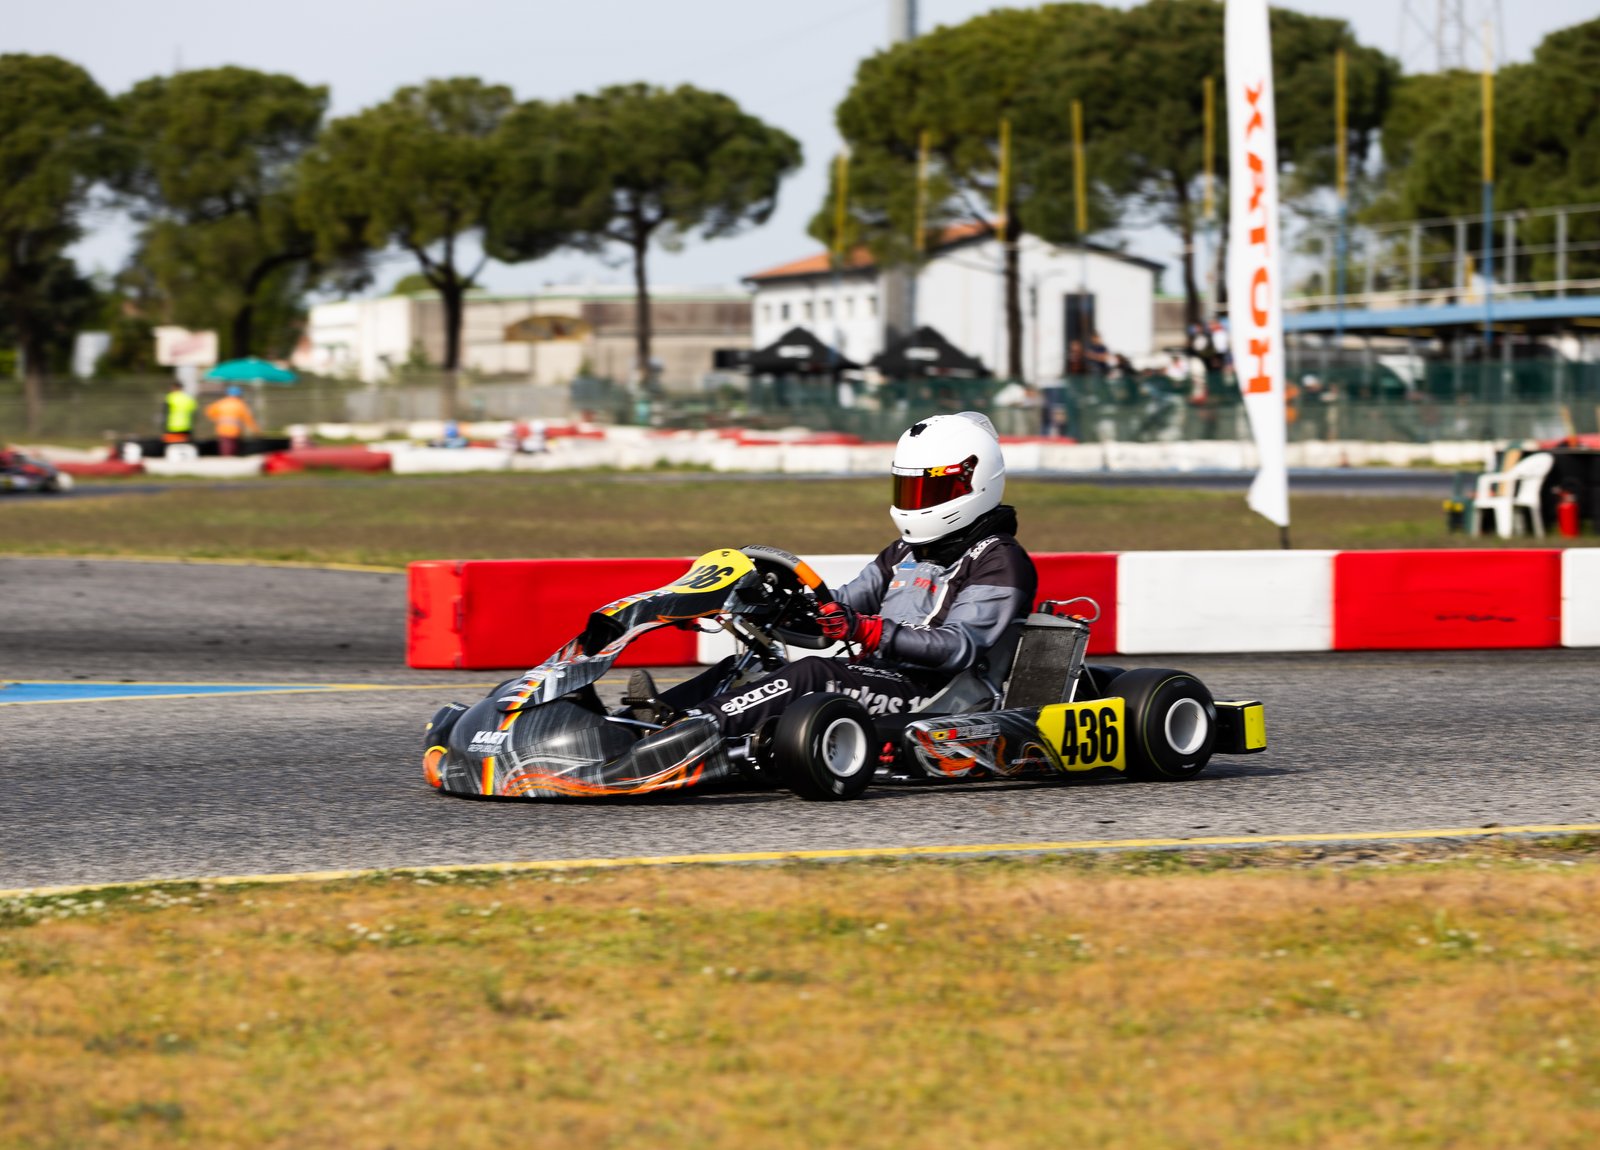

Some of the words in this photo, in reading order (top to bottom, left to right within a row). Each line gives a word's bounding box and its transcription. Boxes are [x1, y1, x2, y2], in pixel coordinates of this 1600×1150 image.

[720, 678, 790, 714] sparco
[470, 731, 510, 745] KART
[1060, 706, 1119, 766] 436
